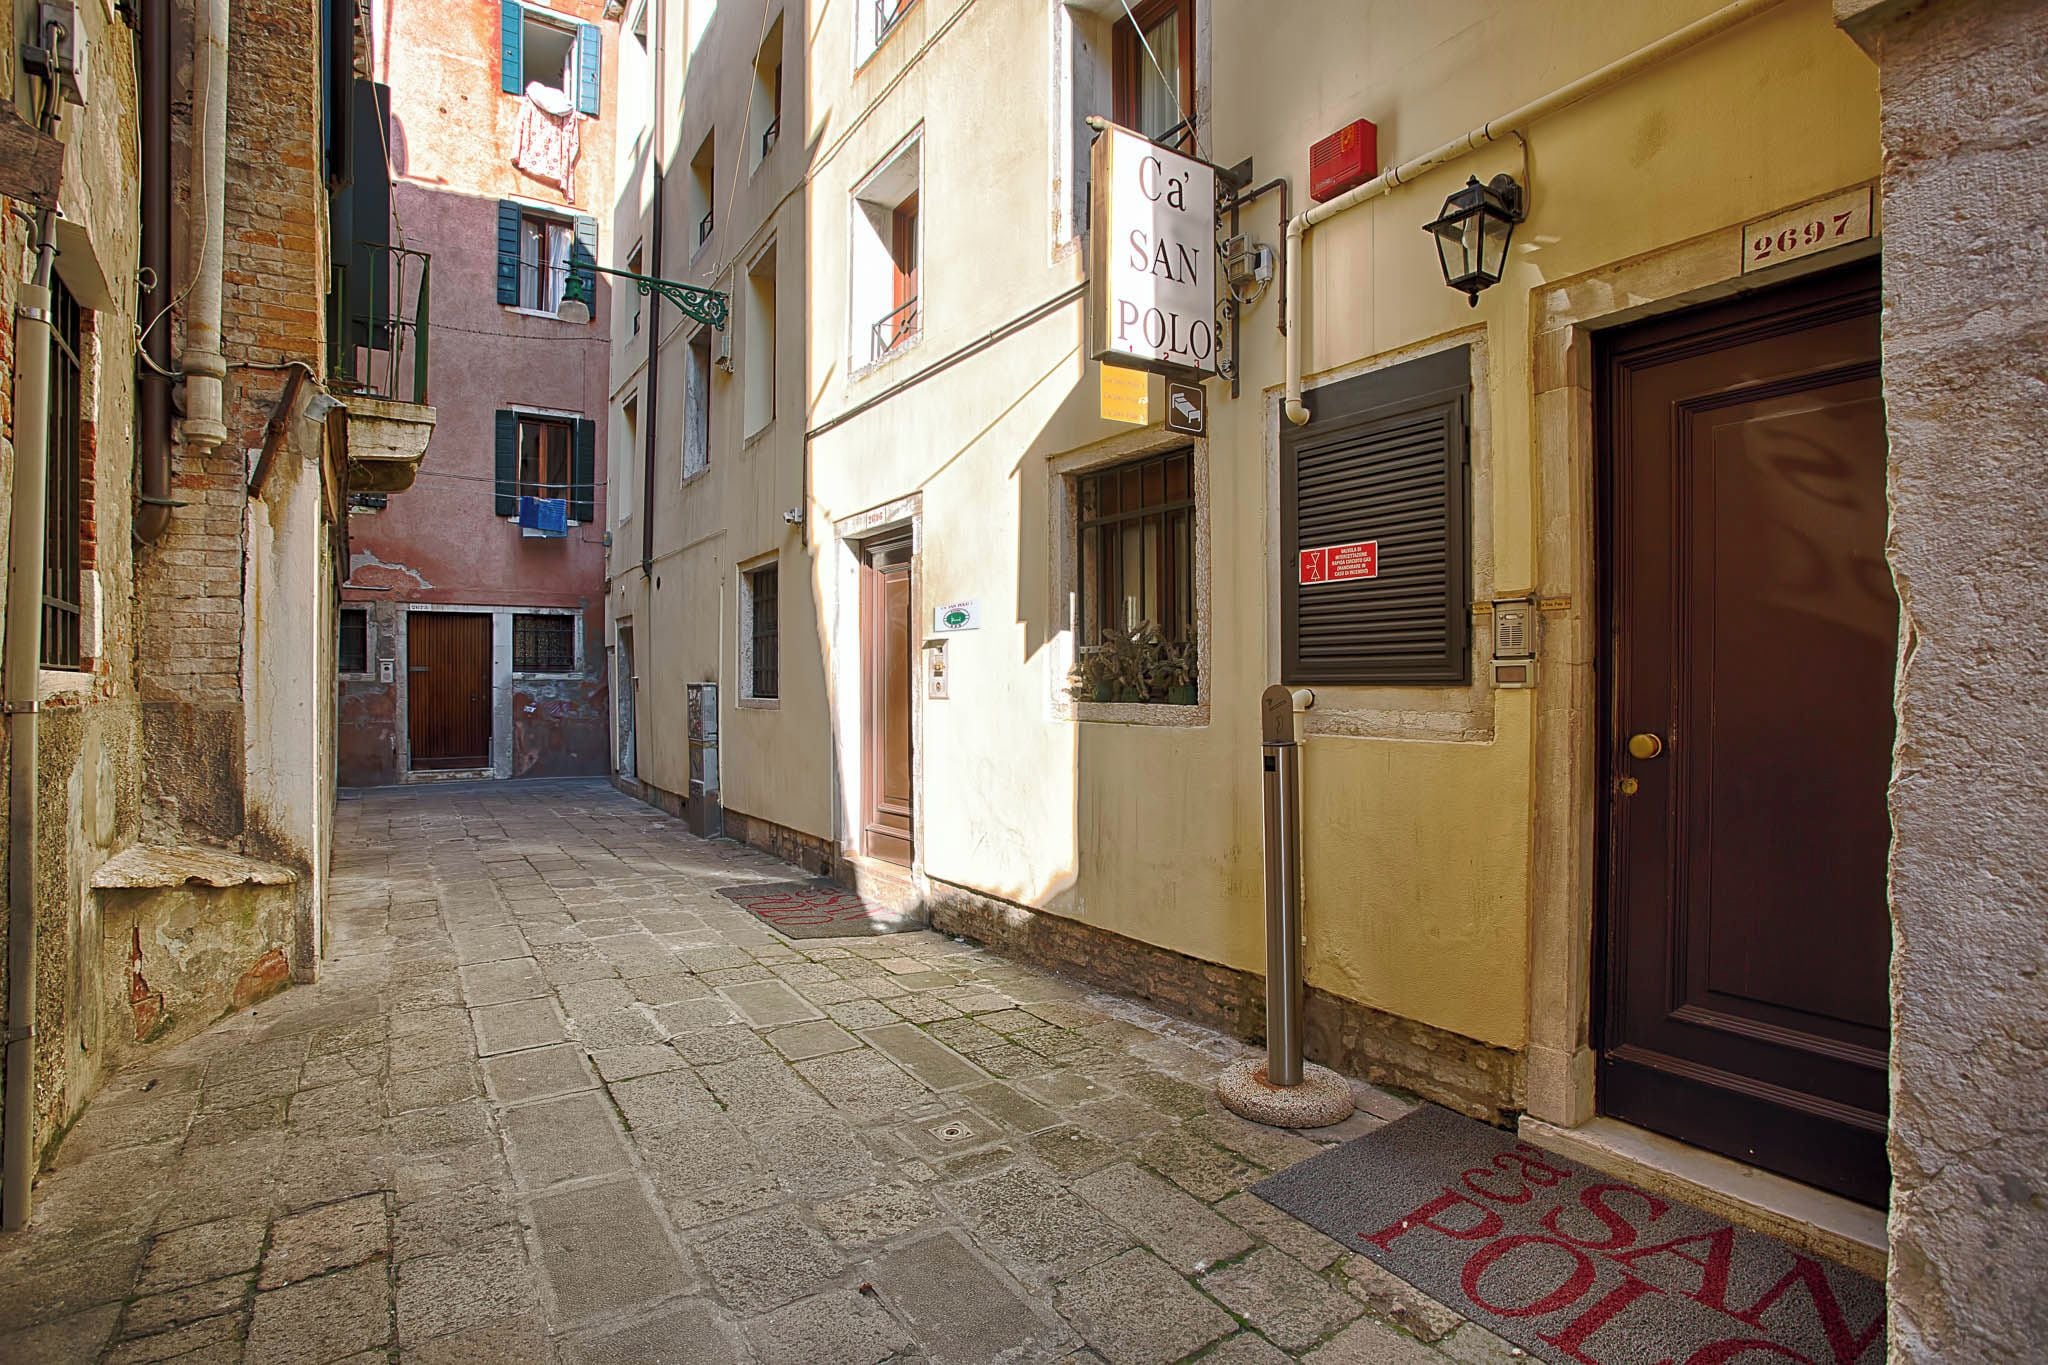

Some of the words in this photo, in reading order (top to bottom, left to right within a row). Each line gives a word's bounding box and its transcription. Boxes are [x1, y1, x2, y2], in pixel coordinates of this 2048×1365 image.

[1139, 156, 1190, 212] Ca'
[1130, 229, 1200, 286] SAN
[1753, 210, 1853, 261] 2697
[1117, 299, 1212, 360] POLO
[1163, 352, 1170, 361] 2
[1194, 359, 1200, 369] 3
[1538, 1183, 1887, 1365] SAN
